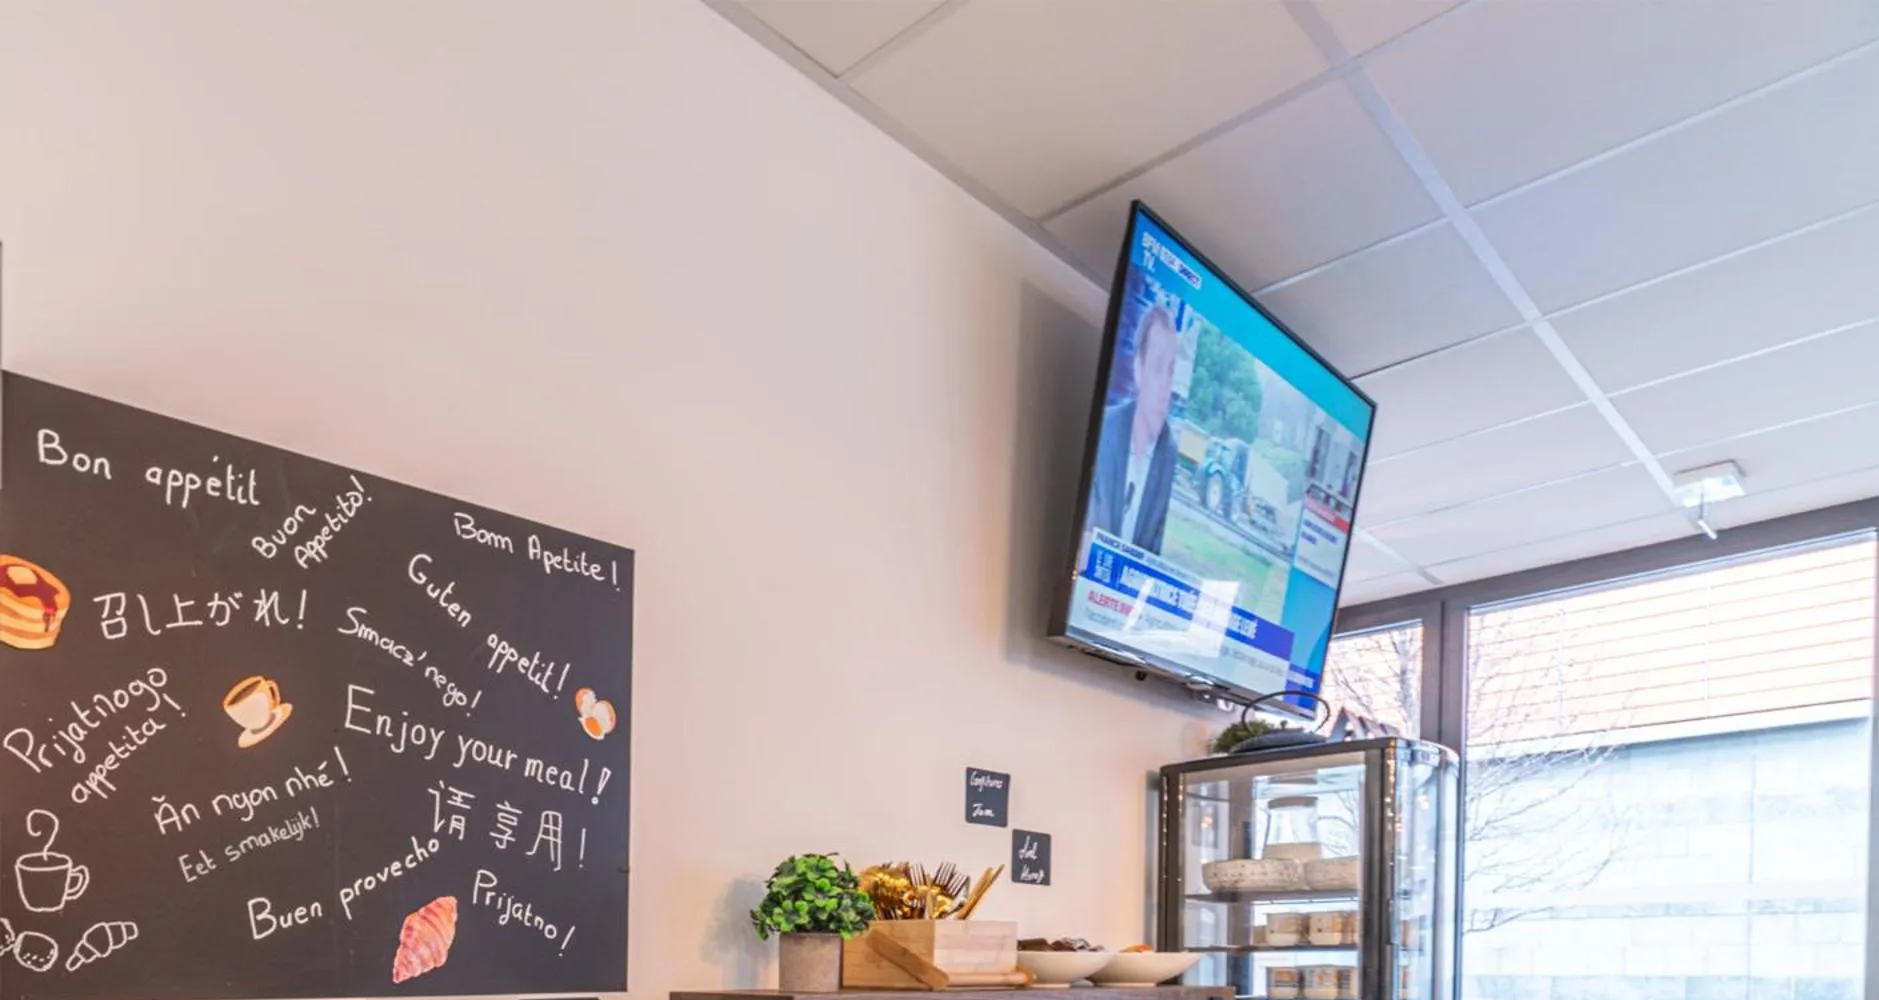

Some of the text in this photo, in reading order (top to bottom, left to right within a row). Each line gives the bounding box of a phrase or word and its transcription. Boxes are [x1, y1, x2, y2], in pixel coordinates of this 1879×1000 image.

[37, 429, 260, 509] Bon appétit
[252, 504, 316, 559] Buon
[294, 475, 372, 568] Appetito!
[408, 553, 570, 699] Guten appetit!
[4, 668, 167, 773] Prijatnogo
[344, 684, 611, 805] Enjoy your meal!
[212, 786, 278, 821] ngon
[178, 849, 217, 883] Eet
[248, 836, 440, 940] Buen provecho
[472, 869, 576, 957] Prijatno!
